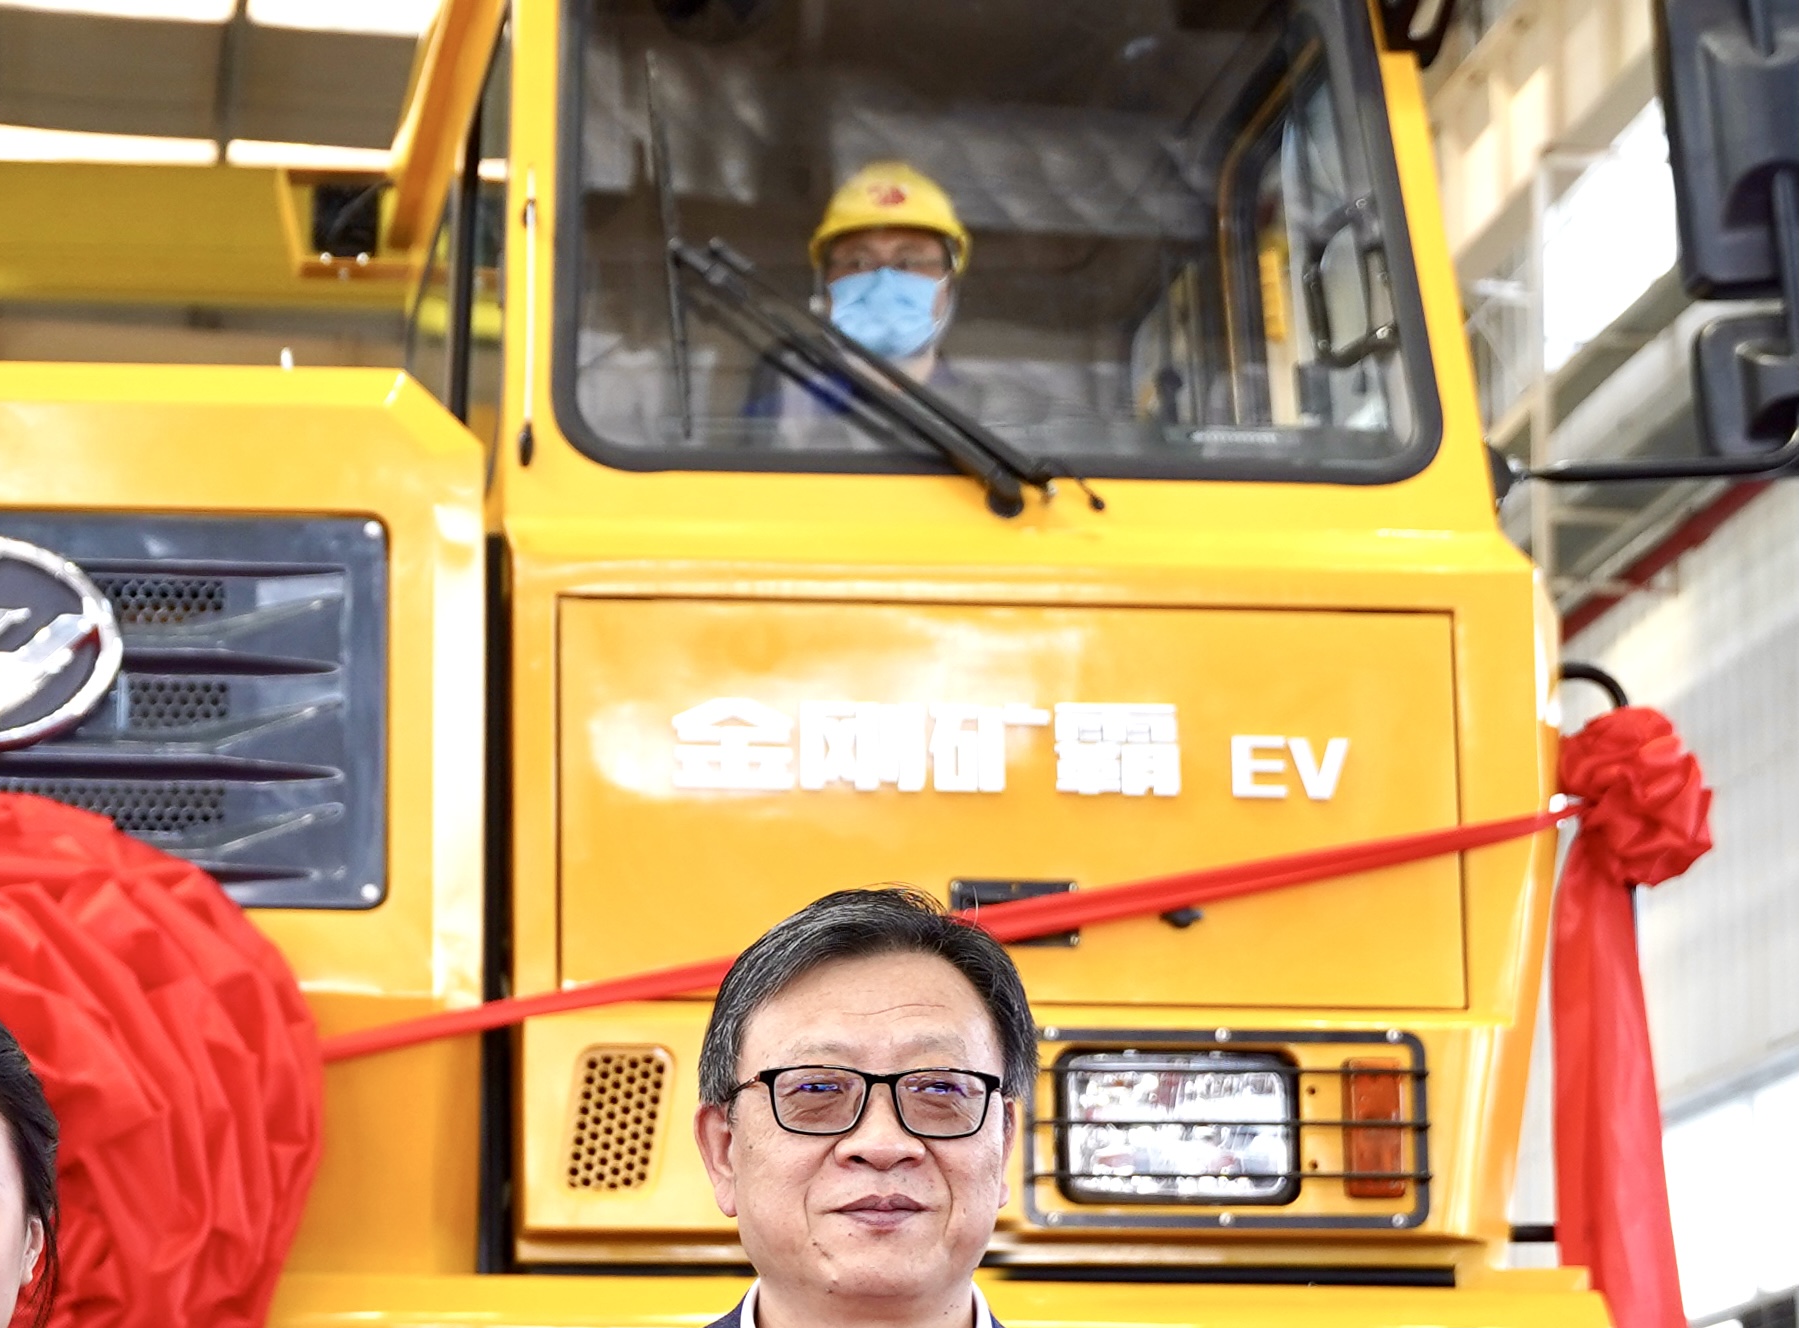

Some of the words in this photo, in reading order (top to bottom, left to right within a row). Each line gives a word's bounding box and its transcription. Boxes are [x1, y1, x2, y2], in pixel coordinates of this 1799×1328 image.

[672, 696, 1181, 795] 金刚矿霸
[1231, 735, 1350, 800] EV
